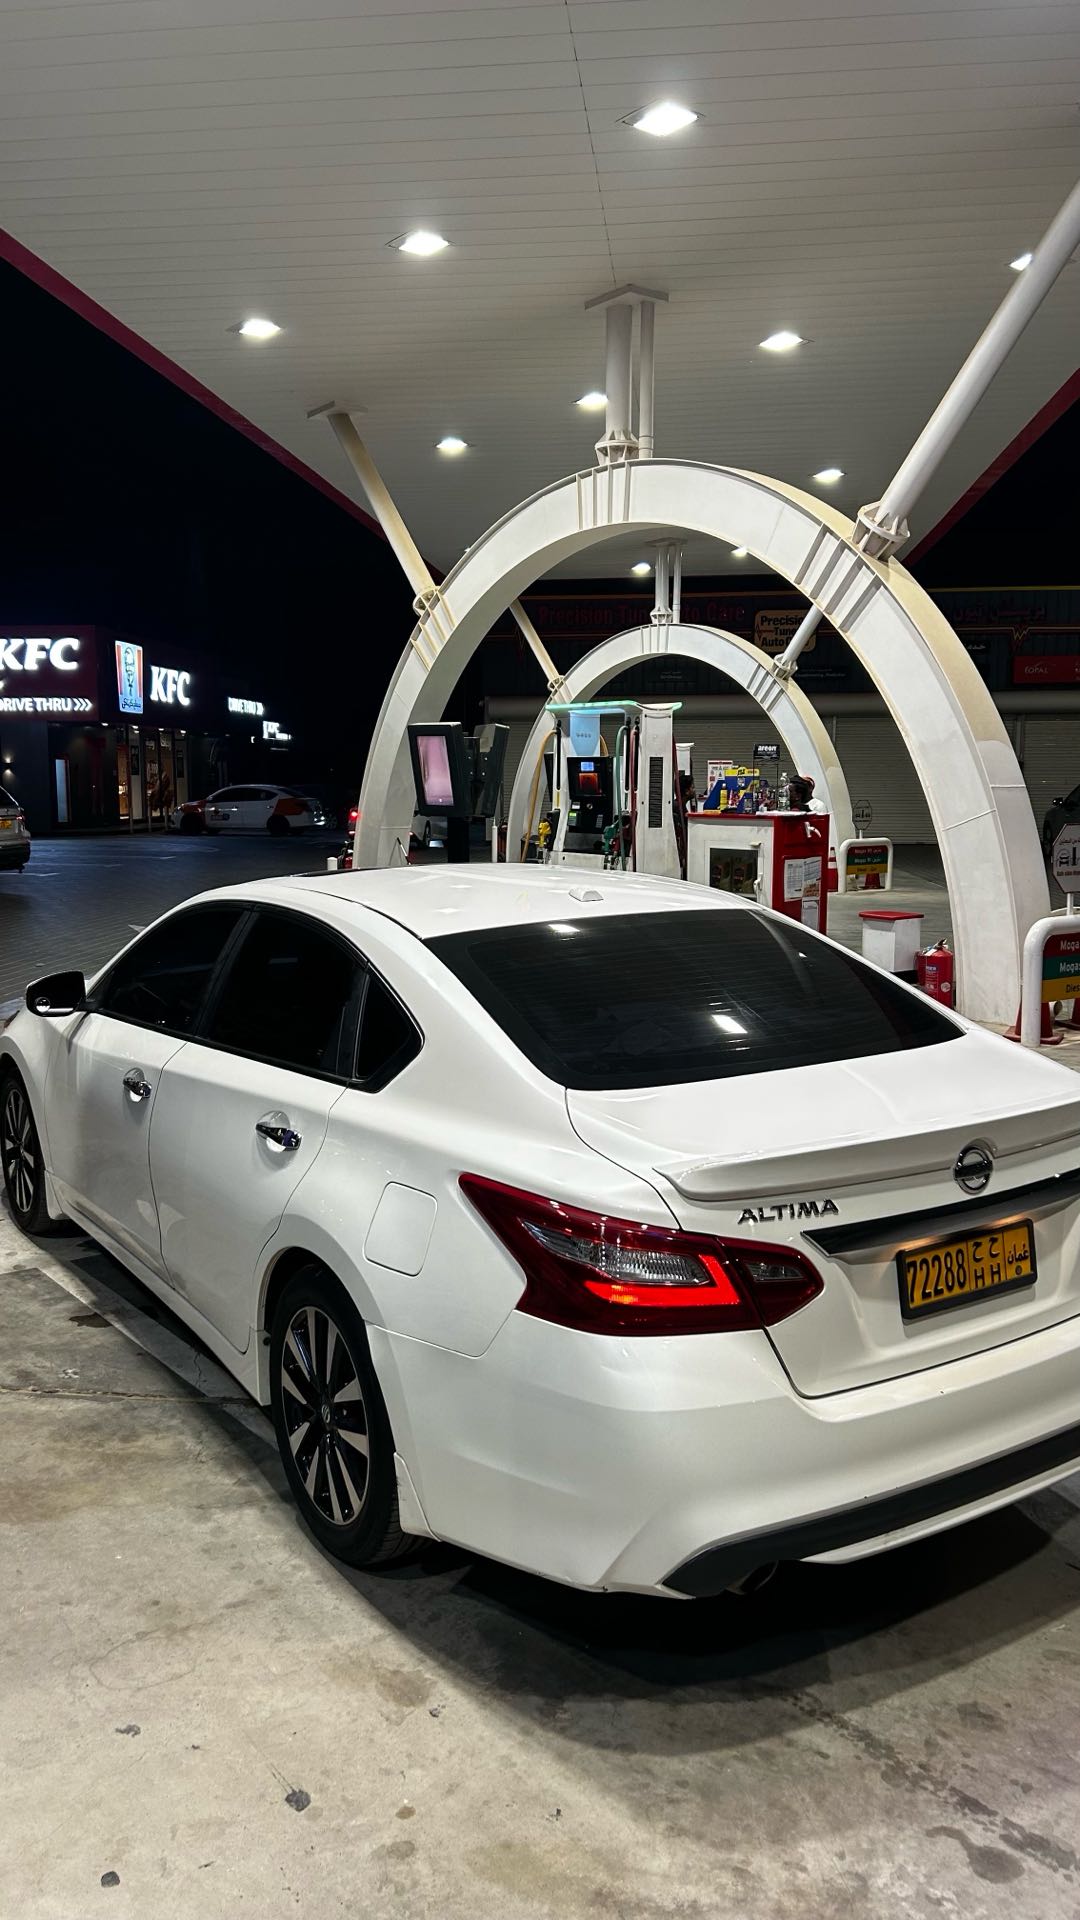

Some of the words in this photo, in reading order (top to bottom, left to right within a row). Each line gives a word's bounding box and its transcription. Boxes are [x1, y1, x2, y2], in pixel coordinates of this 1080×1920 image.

[538, 607, 612, 624] Precision
[760, 615, 804, 626] Precisio
[761, 637, 785, 647] Auto
[0, 637, 81, 671] KFC
[150, 665, 191, 706] KFC
[34, 697, 72, 712] THRU
[737, 1198, 840, 1225] ALTIMA
[907, 1248, 967, 1303] 72288
